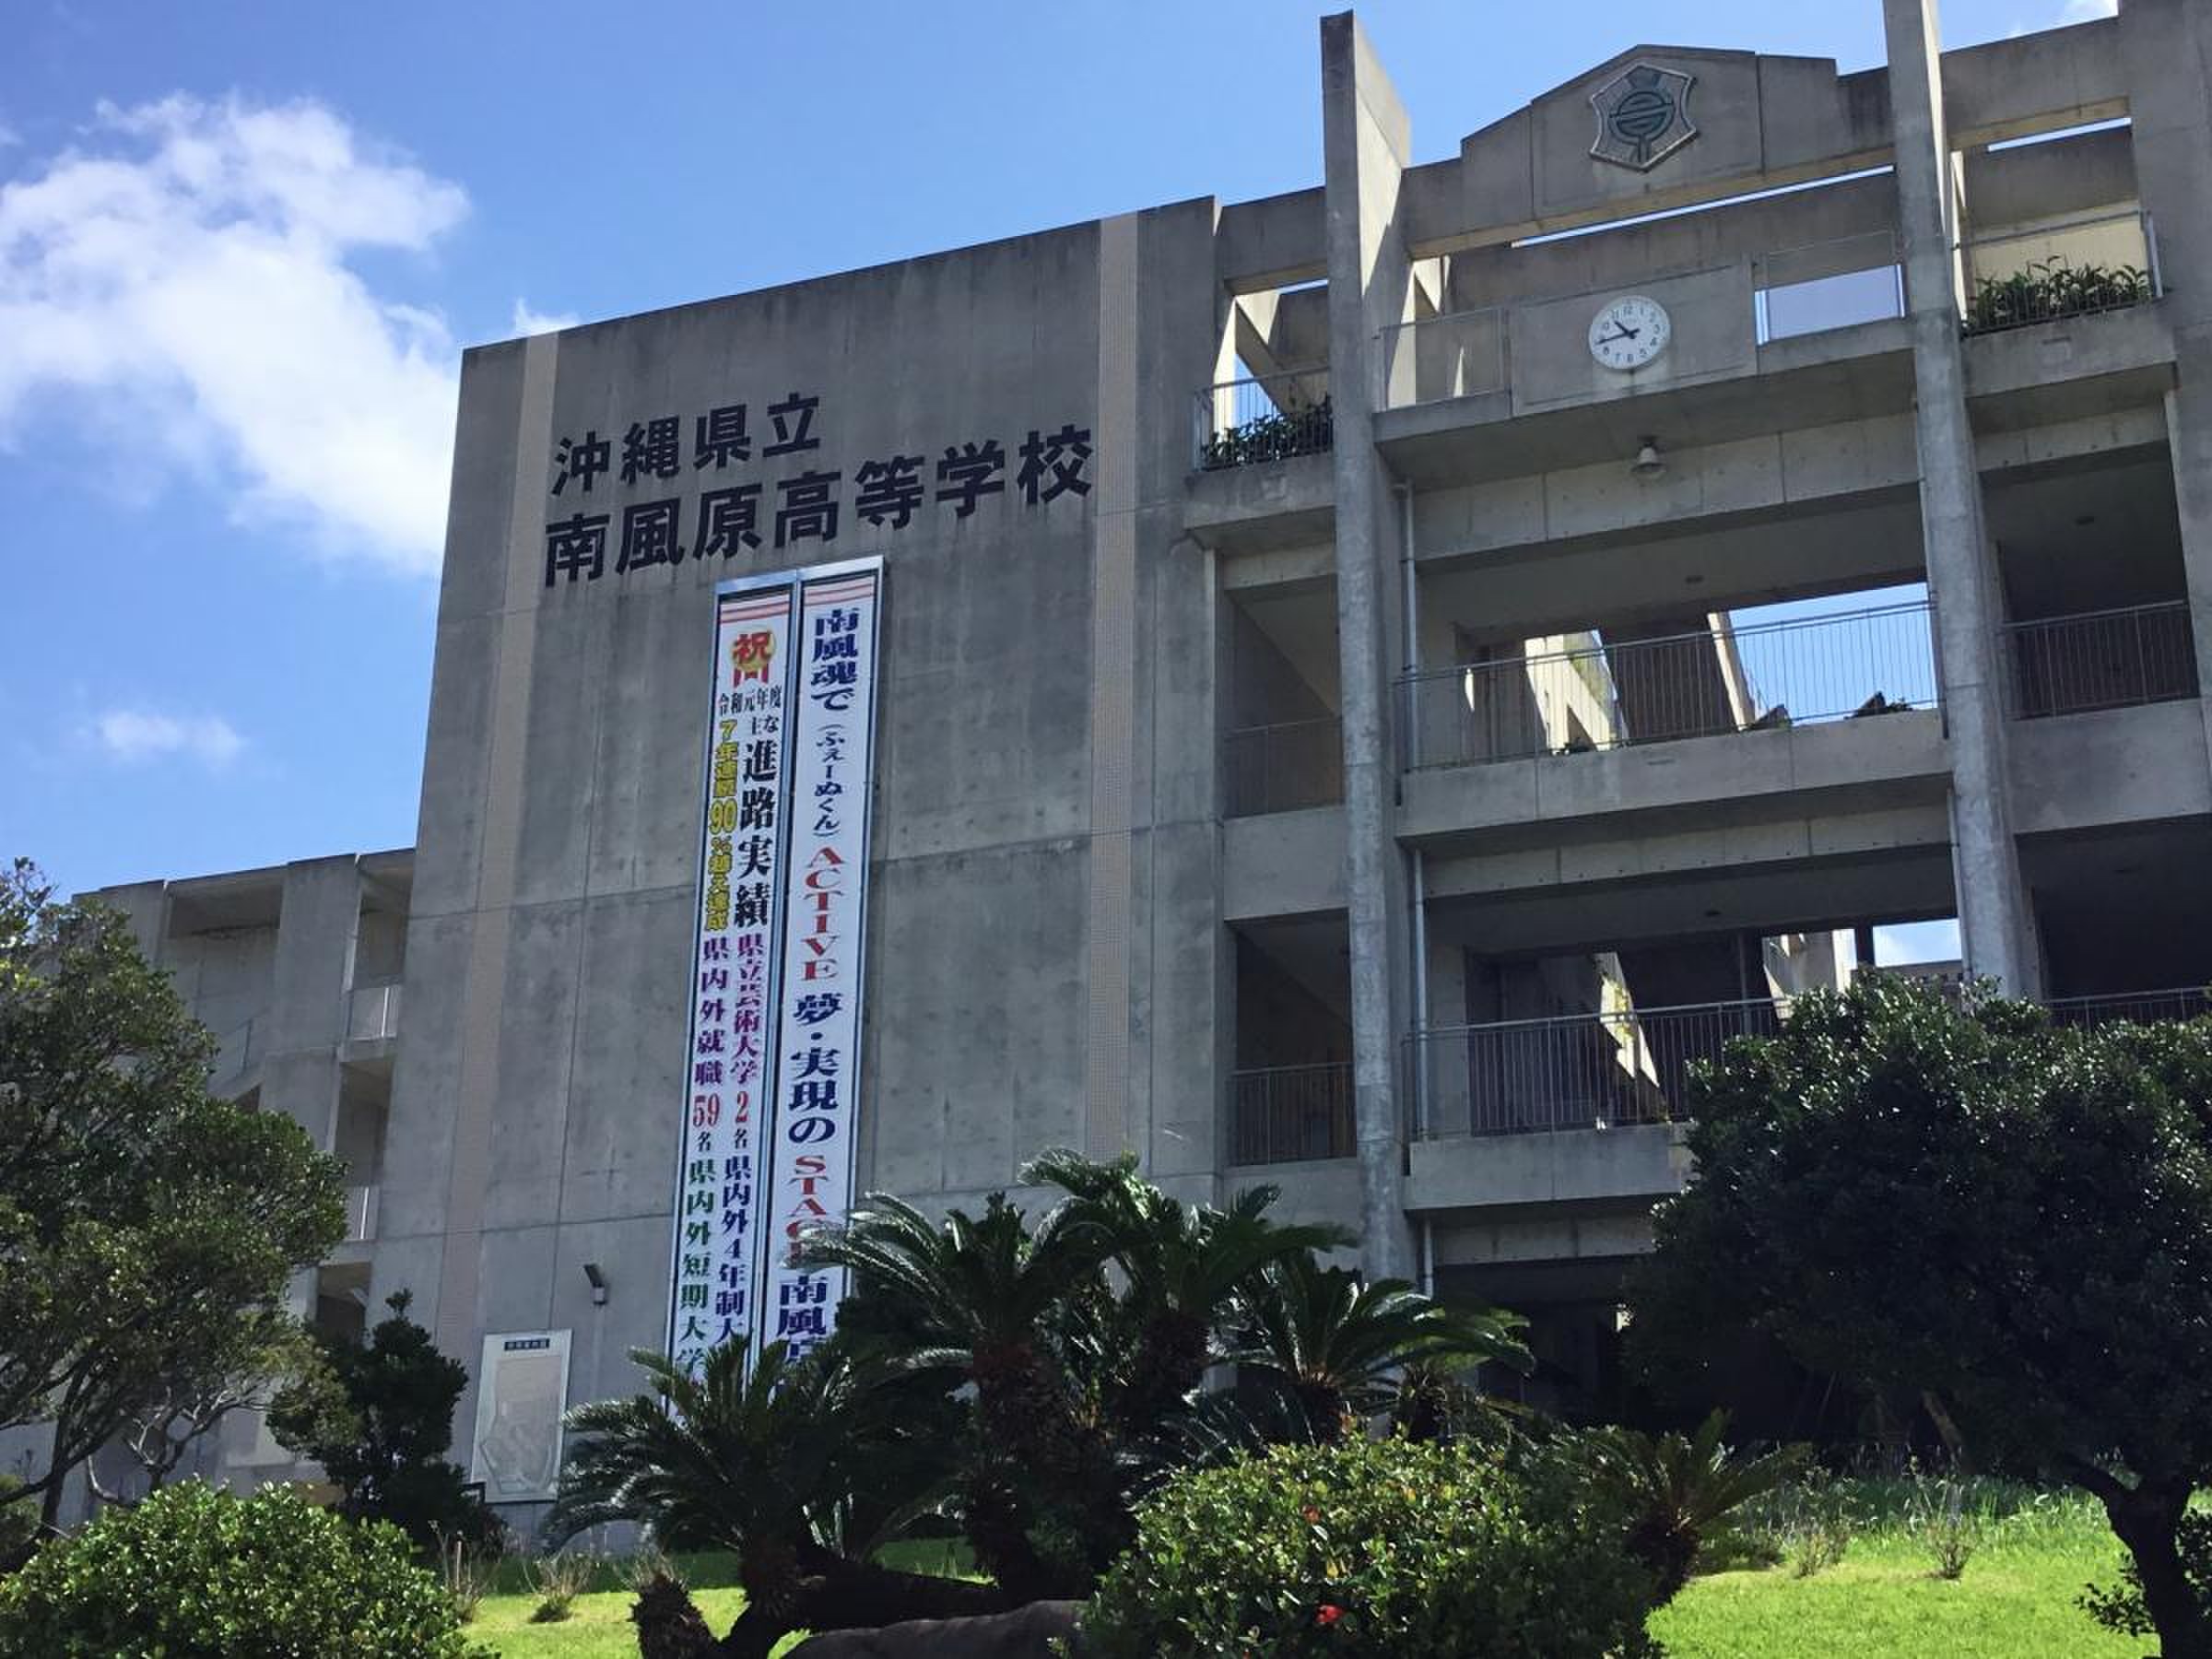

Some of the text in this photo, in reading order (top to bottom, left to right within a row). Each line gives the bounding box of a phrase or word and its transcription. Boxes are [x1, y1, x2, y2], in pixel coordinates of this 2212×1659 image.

[545, 424, 1093, 588] 南風原高等学校
[551, 393, 820, 496] 沖縄県立
[733, 630, 772, 664] 祝
[734, 739, 778, 927] 進路実績
[801, 846, 845, 981] ACTIVE
[788, 993, 843, 1144] 夢・実現の
